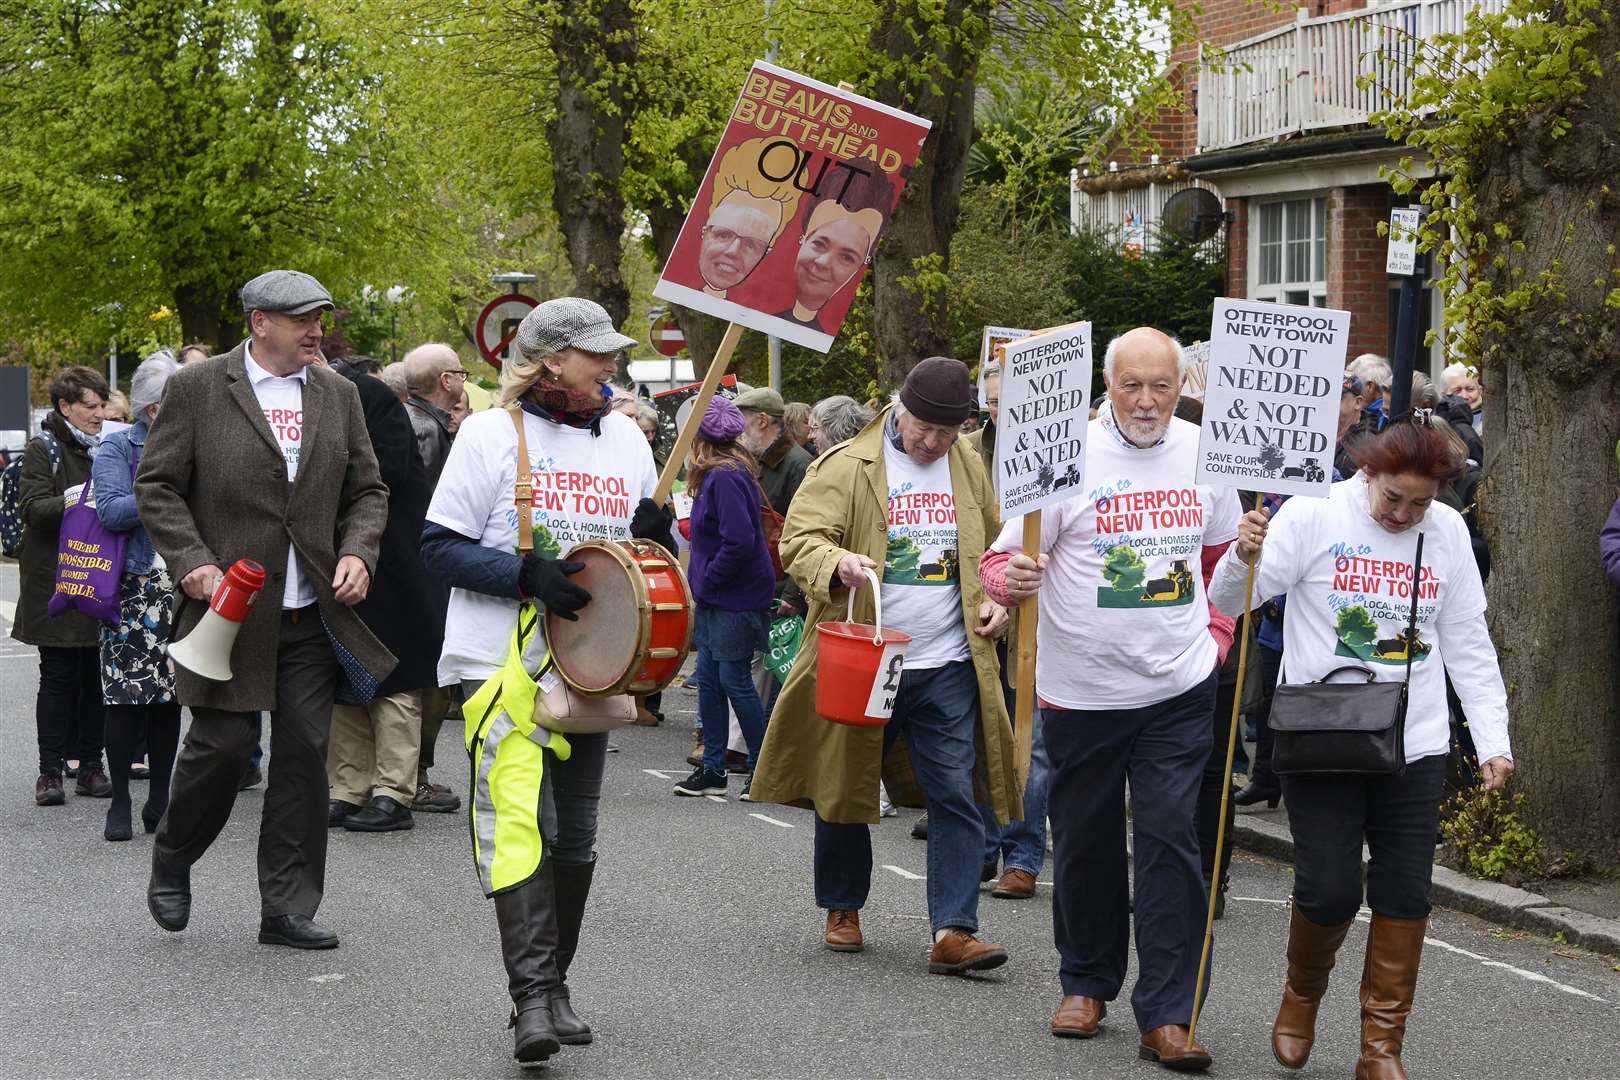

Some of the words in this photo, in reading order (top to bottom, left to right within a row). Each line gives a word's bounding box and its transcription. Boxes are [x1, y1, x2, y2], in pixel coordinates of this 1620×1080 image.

[744, 73, 853, 129] BEAVIS
[849, 123, 879, 139] AND
[734, 98, 902, 174] BUTT-HEAD
[758, 140, 872, 205] OUT
[1224, 308, 1338, 331] OTTERPOOL
[1226, 322, 1271, 338] NEW
[1274, 327, 1334, 344] TOWN
[1012, 334, 1086, 365] OTTERPOOL
[1247, 343, 1308, 370] NOT
[1013, 359, 1043, 377] NEW
[1045, 348, 1084, 368] TOWN
[1027, 369, 1067, 399] NOT
[1217, 365, 1331, 398] NEEDED
[1008, 389, 1083, 428] NEEDED
[1227, 398, 1249, 420] &
[1256, 401, 1316, 427] NOT
[1014, 432, 1029, 453] &
[1034, 418, 1074, 447] NOT
[1209, 420, 1328, 453] WANTED
[1003, 439, 1082, 479] WANTED
[1205, 463, 1277, 480] COUNTRYSIDE
[1207, 452, 1232, 464] SAVE
[1234, 455, 1257, 466] OUR
[531, 471, 629, 497] TTERPOOL
[1005, 486, 1021, 499] SAVE
[1022, 482, 1038, 493] OUR
[1116, 479, 1132, 491] to
[516, 489, 567, 511] EW
[572, 493, 629, 519] TOWN
[1005, 488, 1051, 509] COUNTRYSIDE
[1095, 489, 1202, 515] OTTERPOOL
[535, 510, 548, 521] to
[925, 509, 958, 524] TOW
[1096, 512, 1143, 534] NEW
[1149, 508, 1203, 529] TOWN
[67, 539, 101, 554] WHERE
[908, 530, 932, 538] LOCAL
[916, 538, 940, 546] LOCAL
[1119, 534, 1131, 544] to
[1129, 537, 1158, 548] LOCAL
[1160, 535, 1190, 545] HOMES
[1140, 547, 1169, 557] LOCAL
[1329, 542, 1354, 559] No
[1357, 544, 1372, 555] to
[1335, 555, 1440, 582] OTTERPOOL
[1333, 574, 1381, 594] NEW
[1386, 580, 1440, 599] TOWN
[1327, 593, 1350, 613] Yes
[1352, 594, 1365, 604] to
[1363, 600, 1392, 611] LOCAL
[1373, 610, 1402, 621] LOCAL
[882, 654, 904, 692] £
